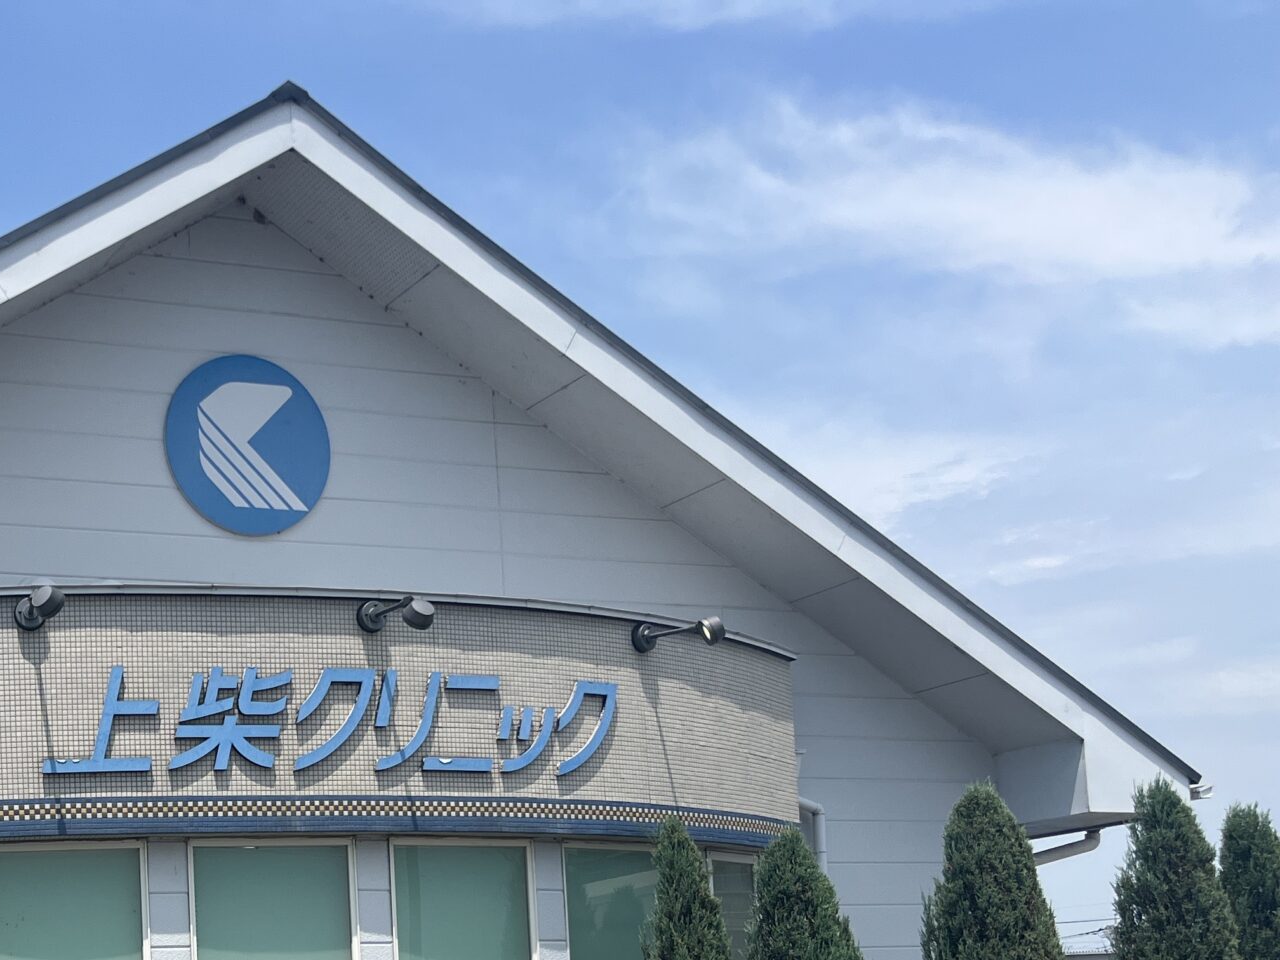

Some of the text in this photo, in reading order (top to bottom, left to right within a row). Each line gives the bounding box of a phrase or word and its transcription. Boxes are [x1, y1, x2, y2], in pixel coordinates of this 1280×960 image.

[42, 664, 617, 776] 上柴クリニック
